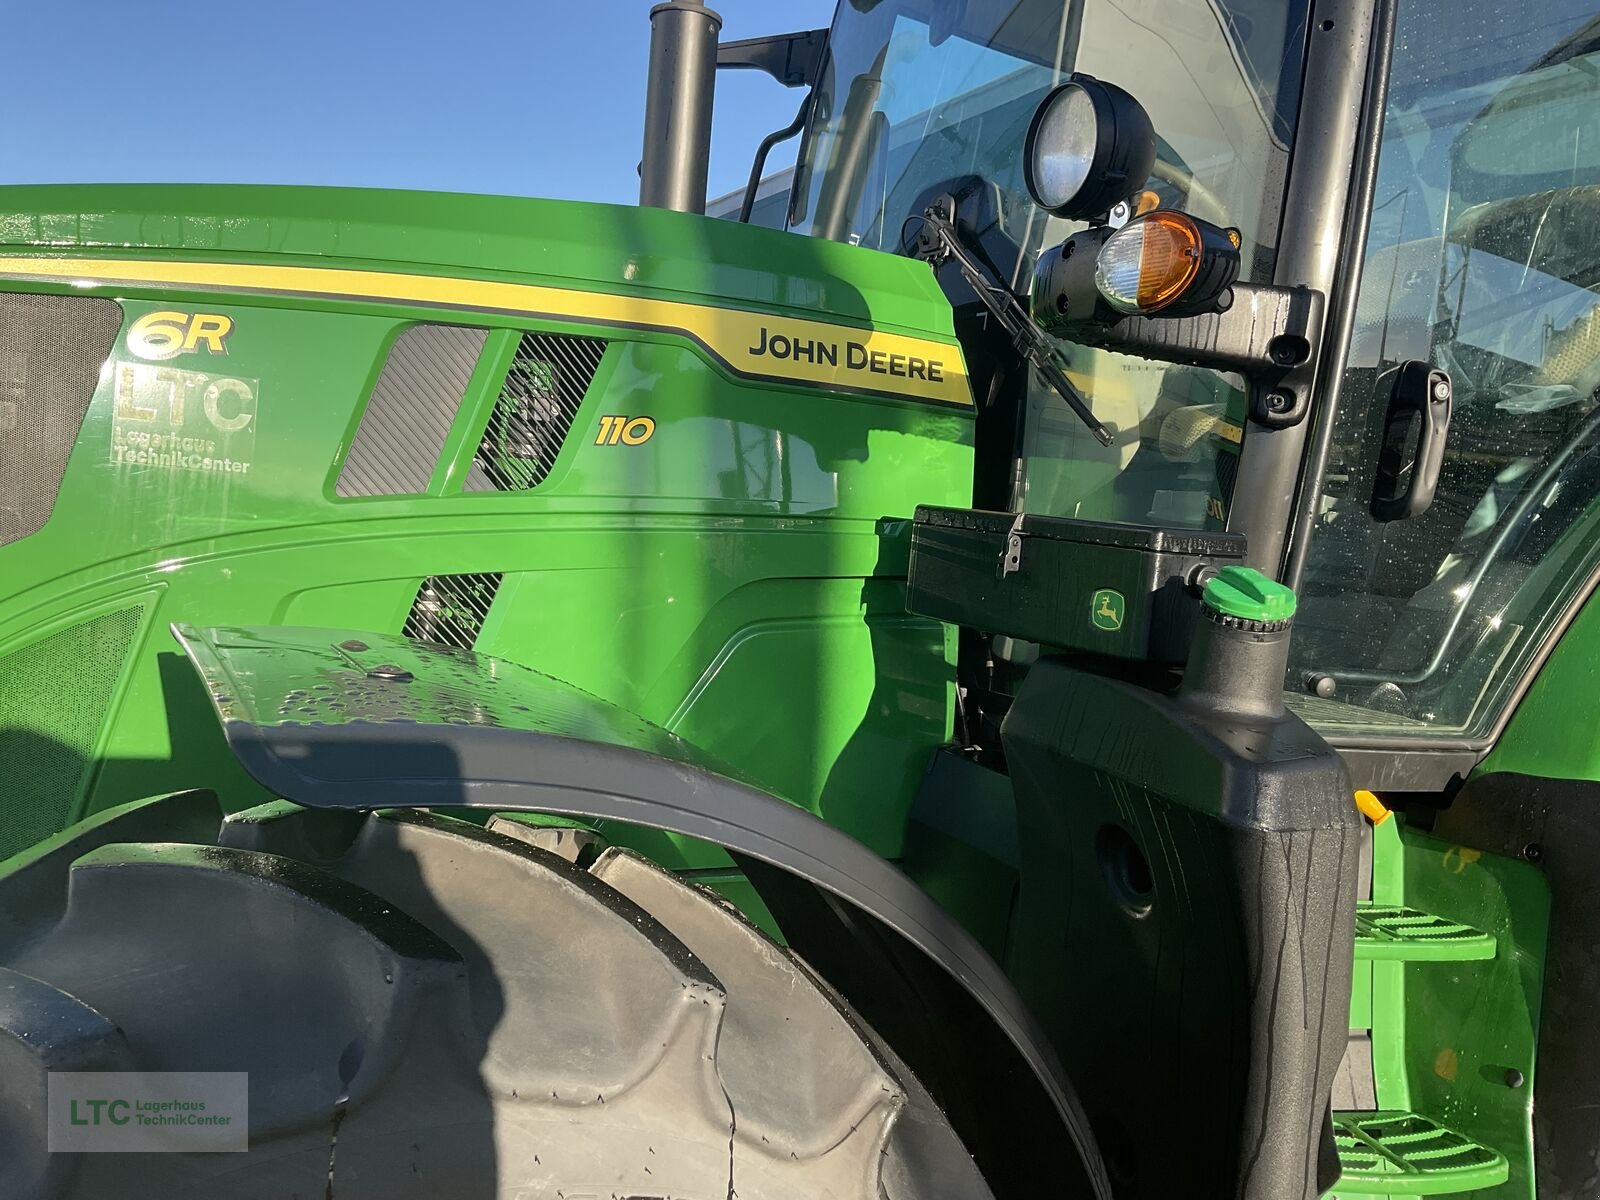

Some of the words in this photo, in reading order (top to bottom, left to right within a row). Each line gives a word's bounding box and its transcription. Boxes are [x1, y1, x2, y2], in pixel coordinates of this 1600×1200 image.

[126, 311, 233, 360] 6R
[117, 367, 253, 430] LTC
[114, 427, 215, 453] Lagerhaus
[594, 415, 656, 446] 110
[114, 445, 250, 473] TechnikCenter
